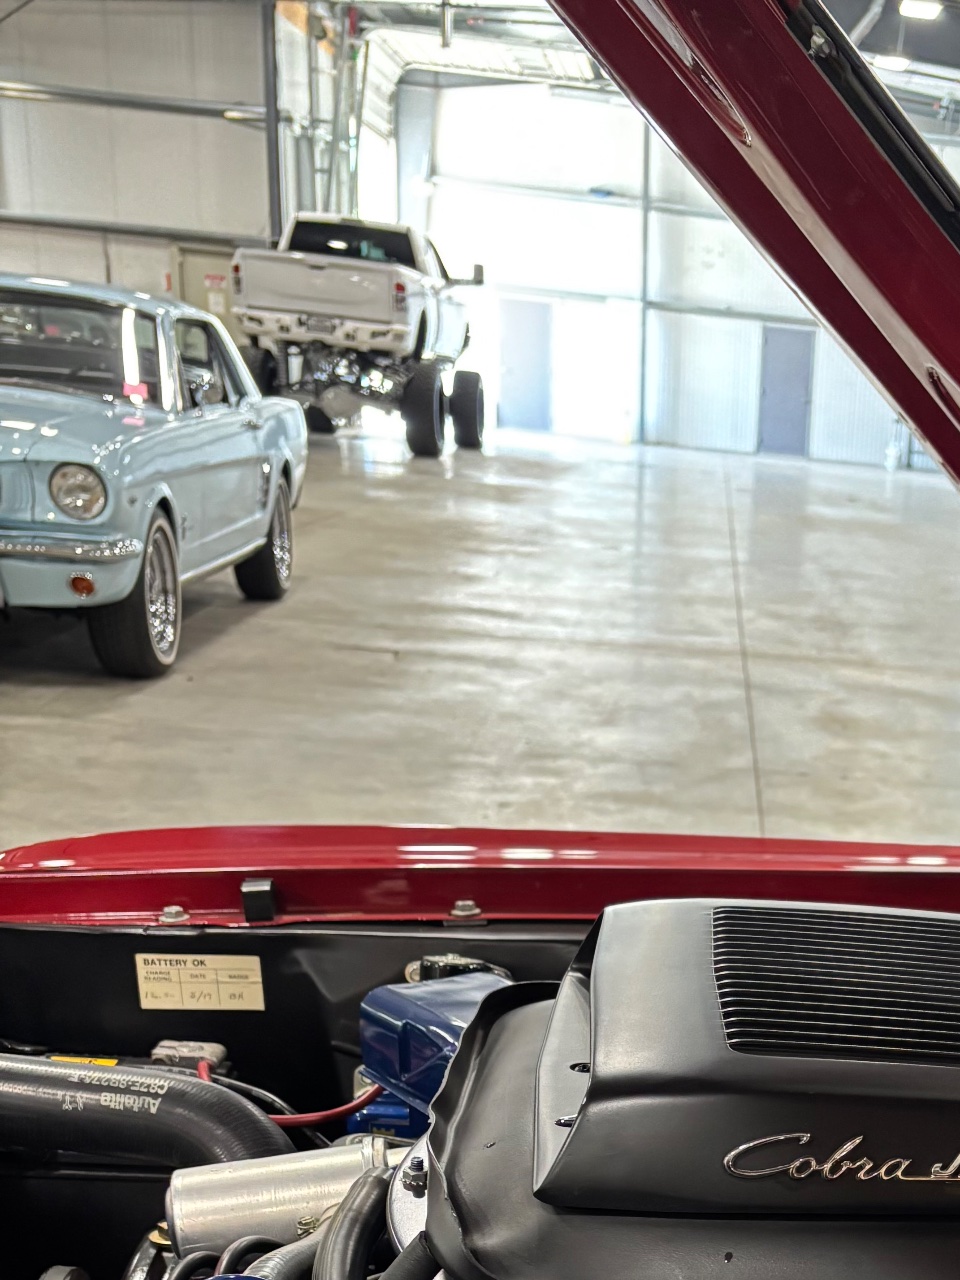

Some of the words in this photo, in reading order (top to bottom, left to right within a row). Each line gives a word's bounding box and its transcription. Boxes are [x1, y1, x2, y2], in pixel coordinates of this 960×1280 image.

[143, 958, 187, 967] BATTERY
[192, 959, 207, 967] OK
[100, 1092, 162, 1114] Autolite
[722, 1132, 913, 1180] Cobra
